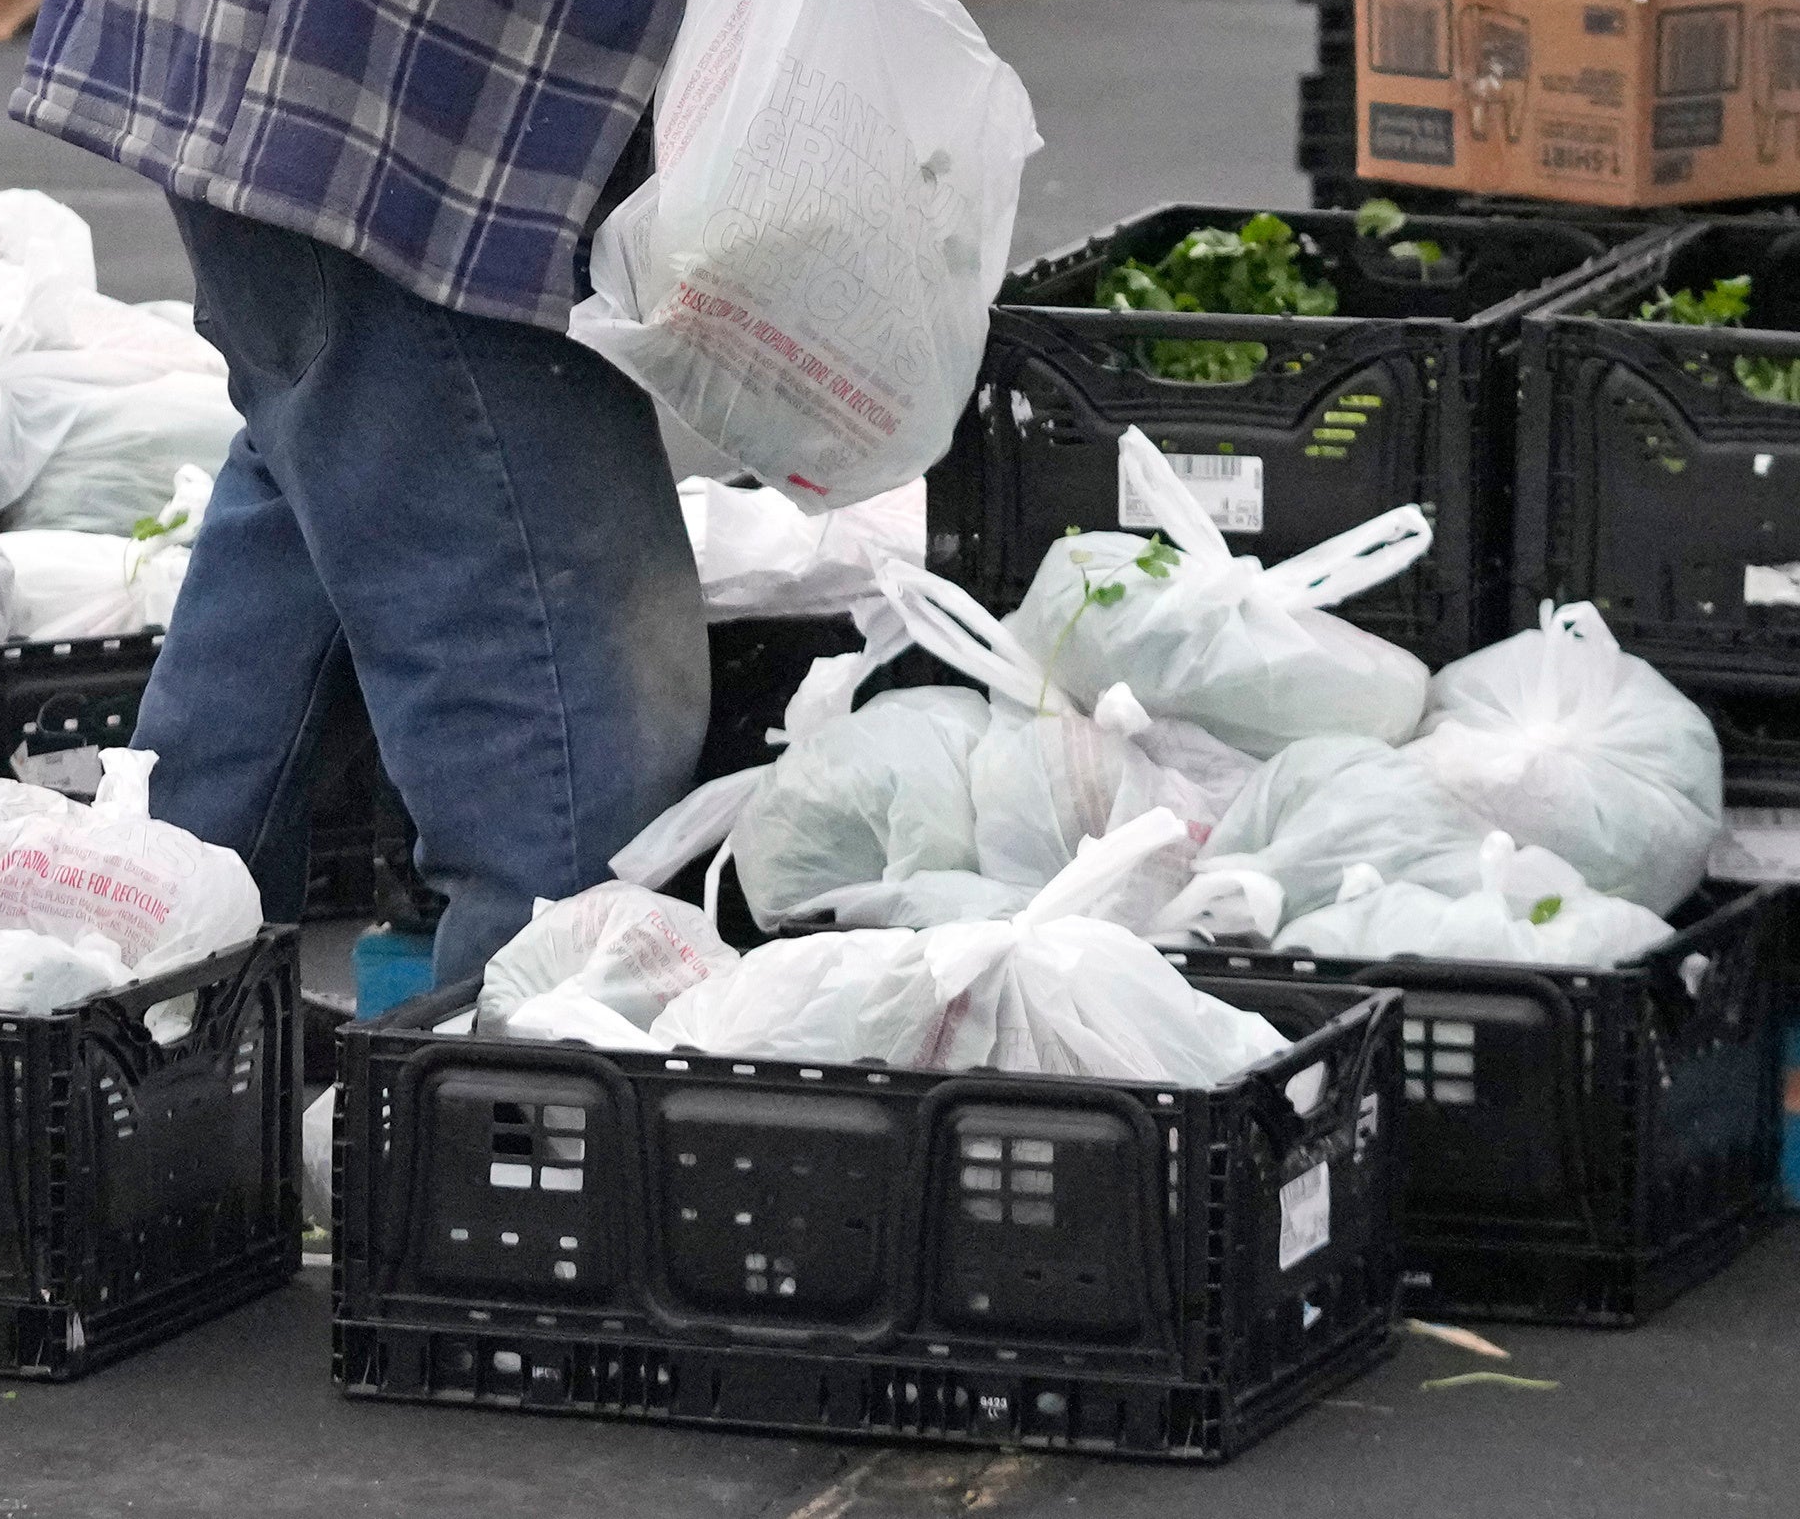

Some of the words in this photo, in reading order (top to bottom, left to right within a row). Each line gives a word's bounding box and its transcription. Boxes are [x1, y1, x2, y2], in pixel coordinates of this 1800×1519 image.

[672, 281, 709, 313] EASE
[748, 317, 805, 364] PAICIPATING
[796, 351, 832, 386] STORE
[827, 372, 855, 401] FOR
[845, 386, 902, 437] RECYCLING
[87, 872, 112, 898] FOR
[111, 881, 172, 924] RECYCLING
[646, 908, 681, 946] PLEASE
